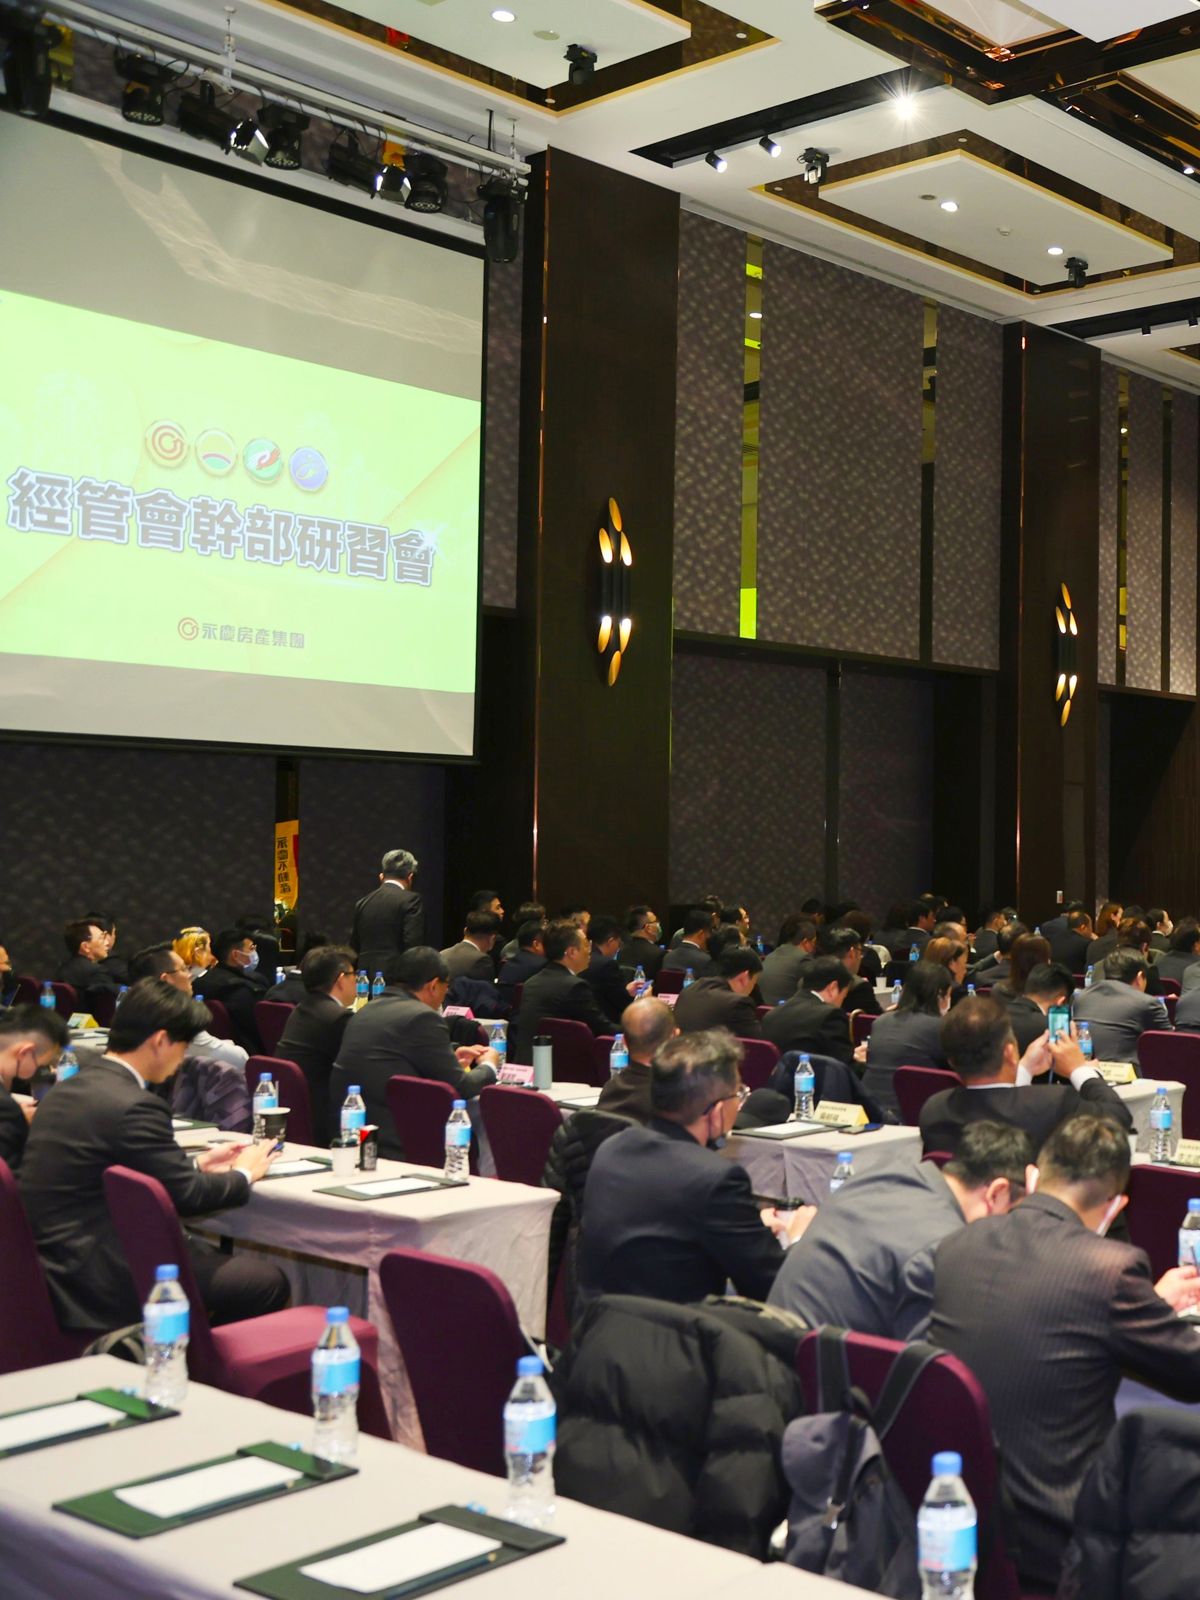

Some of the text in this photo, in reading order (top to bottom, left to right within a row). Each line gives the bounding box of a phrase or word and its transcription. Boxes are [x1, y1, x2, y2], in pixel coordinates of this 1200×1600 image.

[5, 466, 435, 587] 經管會幹部研習會
[202, 622, 304, 649] 永慶房產集團
